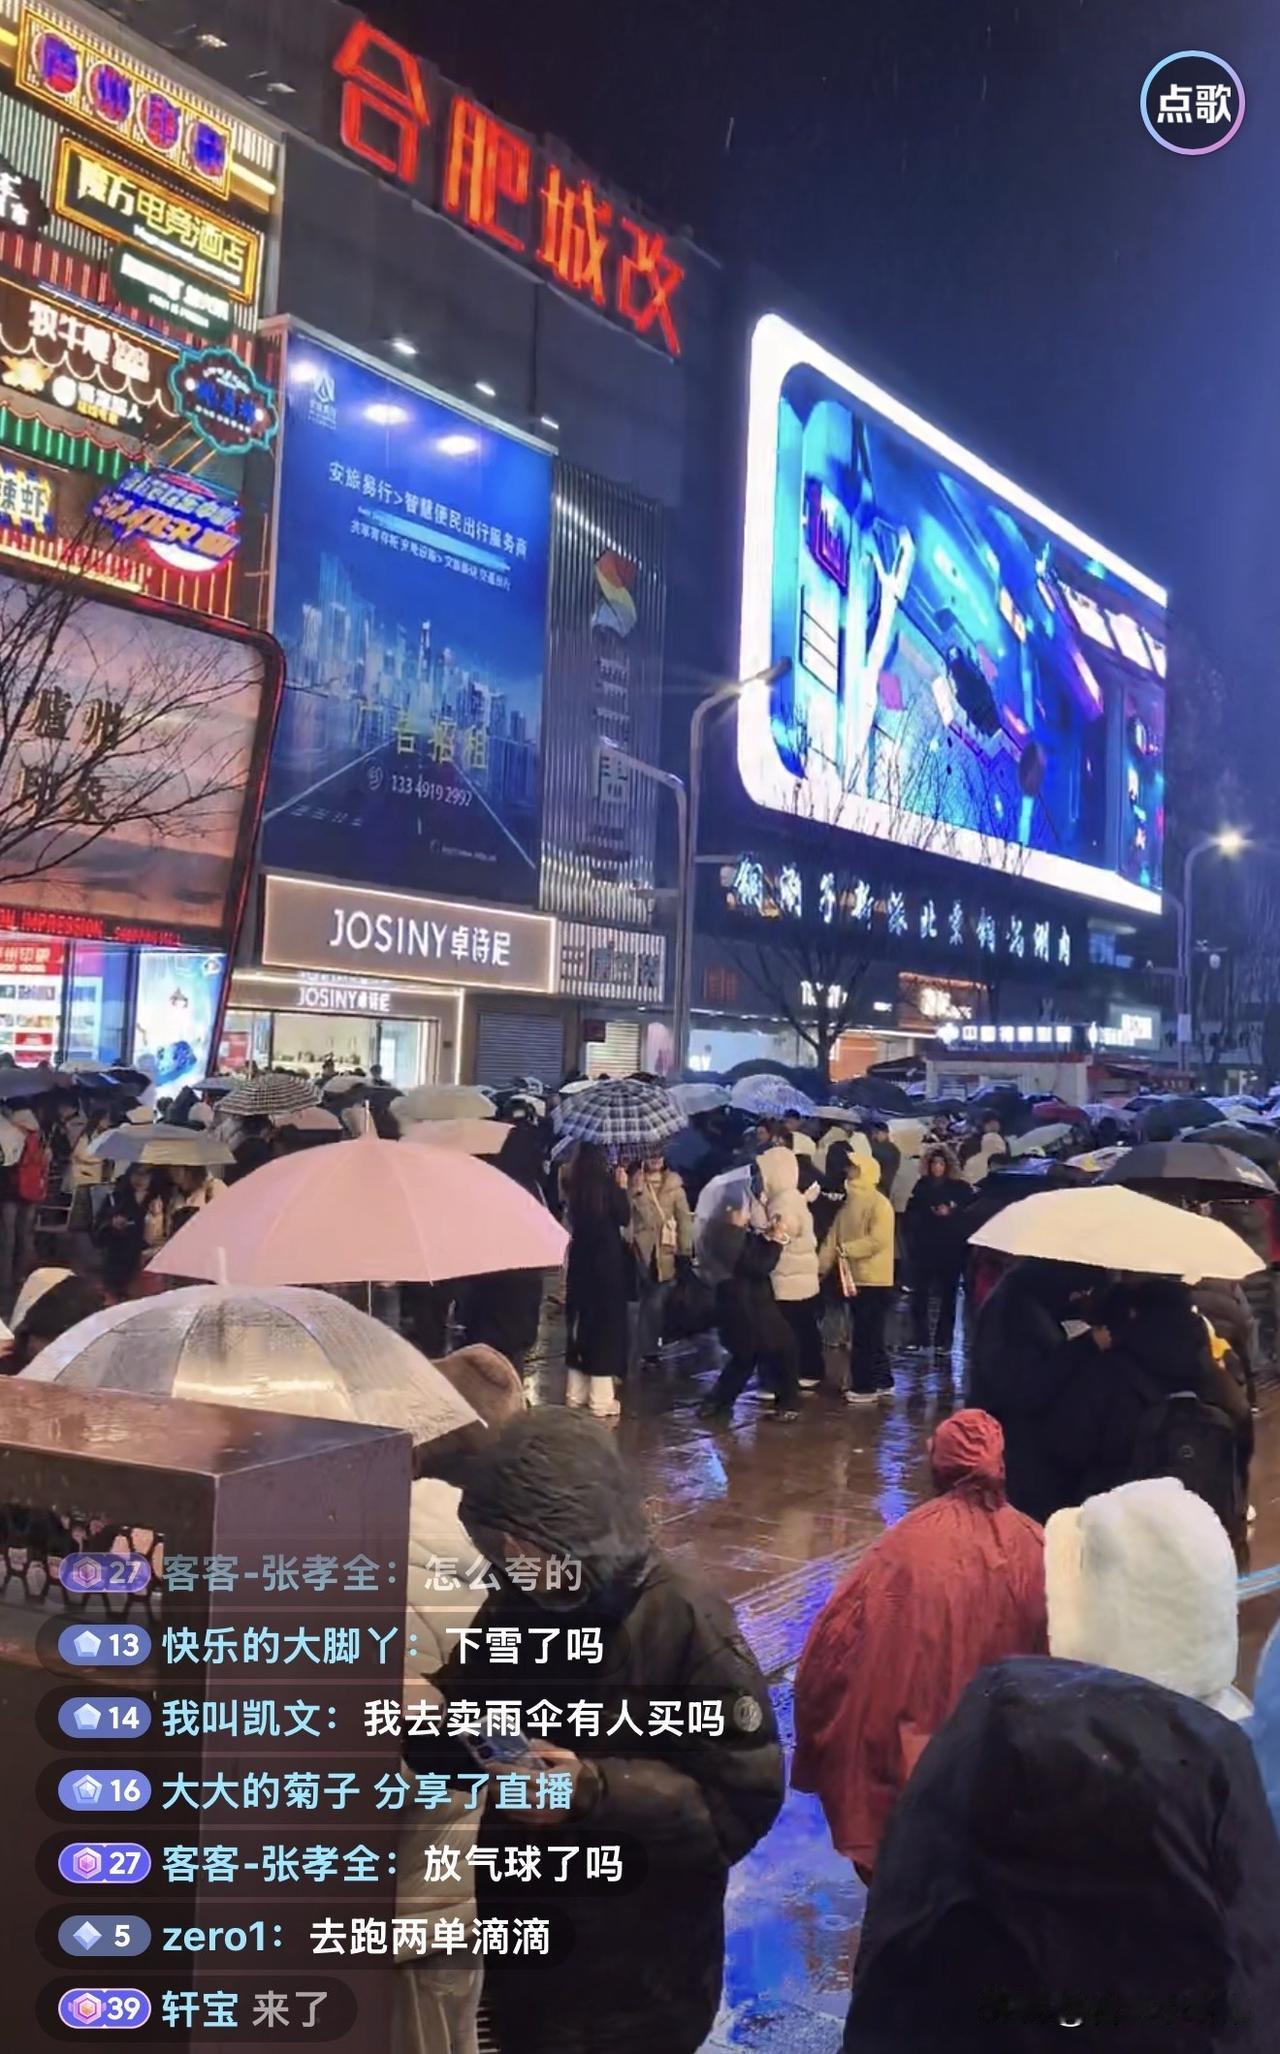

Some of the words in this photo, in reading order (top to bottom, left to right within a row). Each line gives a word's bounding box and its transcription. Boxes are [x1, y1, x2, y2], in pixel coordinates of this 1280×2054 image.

[333, 19, 684, 357] 合肥城改
[392, 774, 413, 795] 133
